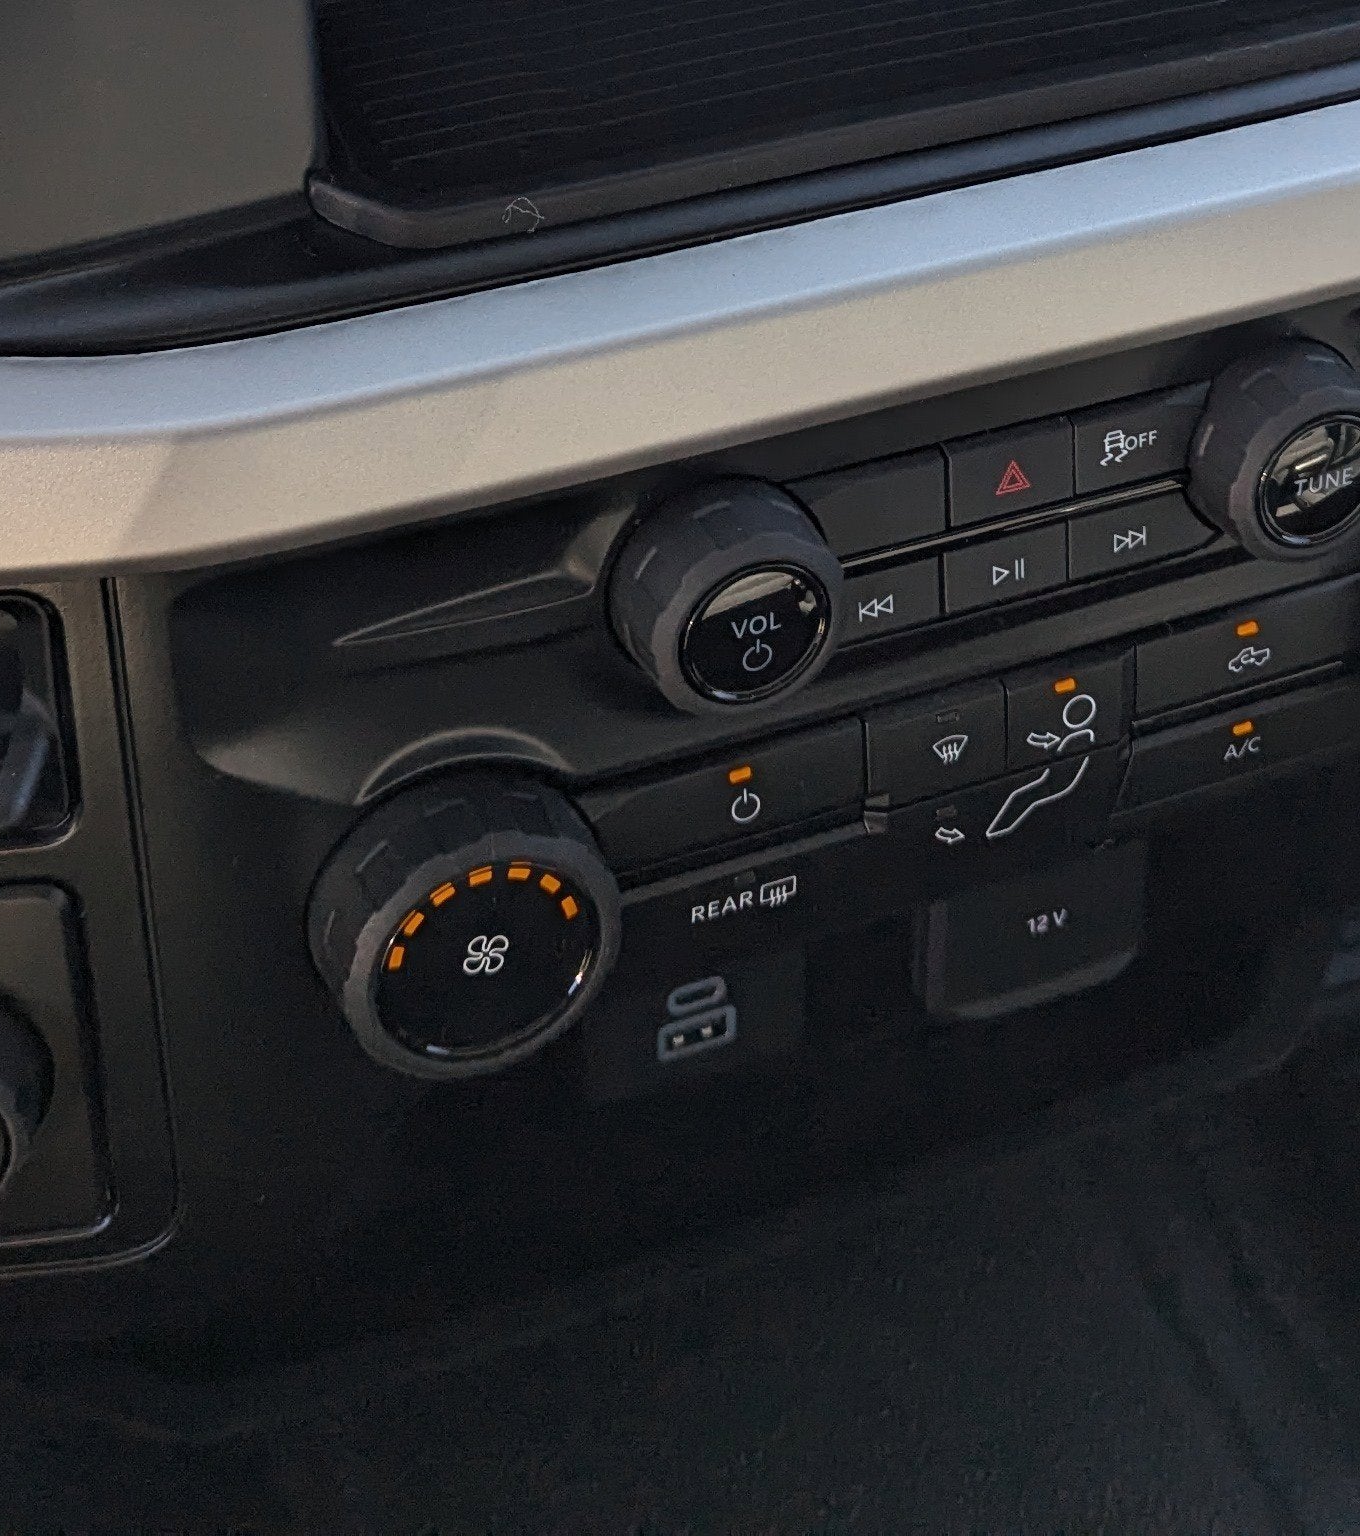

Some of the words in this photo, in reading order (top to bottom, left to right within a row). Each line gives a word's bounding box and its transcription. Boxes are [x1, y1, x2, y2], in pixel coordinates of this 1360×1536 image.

[1125, 430, 1158, 452] OFF
[1294, 466, 1354, 497] TUNE
[731, 612, 782, 639] VOL
[1224, 736, 1261, 761] A/C
[691, 891, 754, 924] REAR
